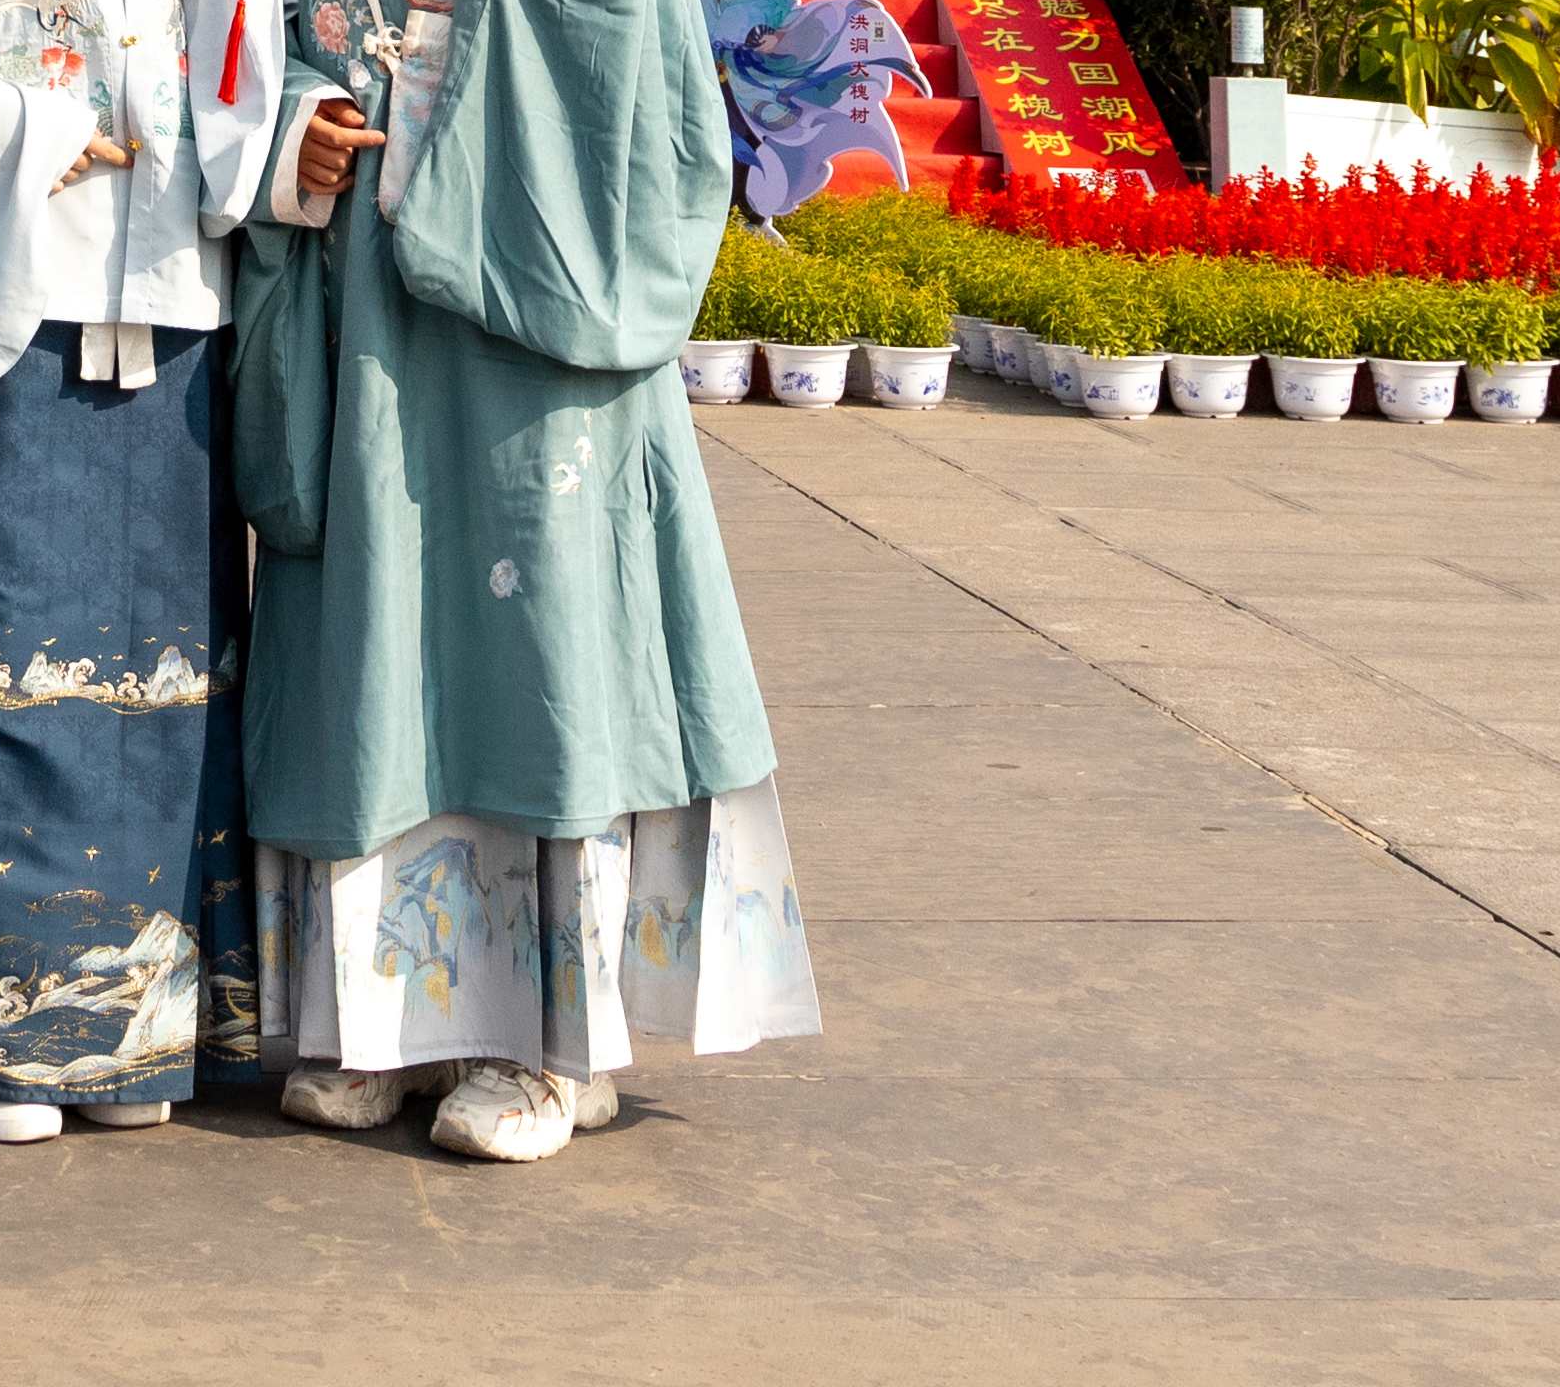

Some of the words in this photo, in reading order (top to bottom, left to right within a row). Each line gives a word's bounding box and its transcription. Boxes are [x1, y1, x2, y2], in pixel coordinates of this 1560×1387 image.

[849, 14, 870, 124] 洪洞大槐树
